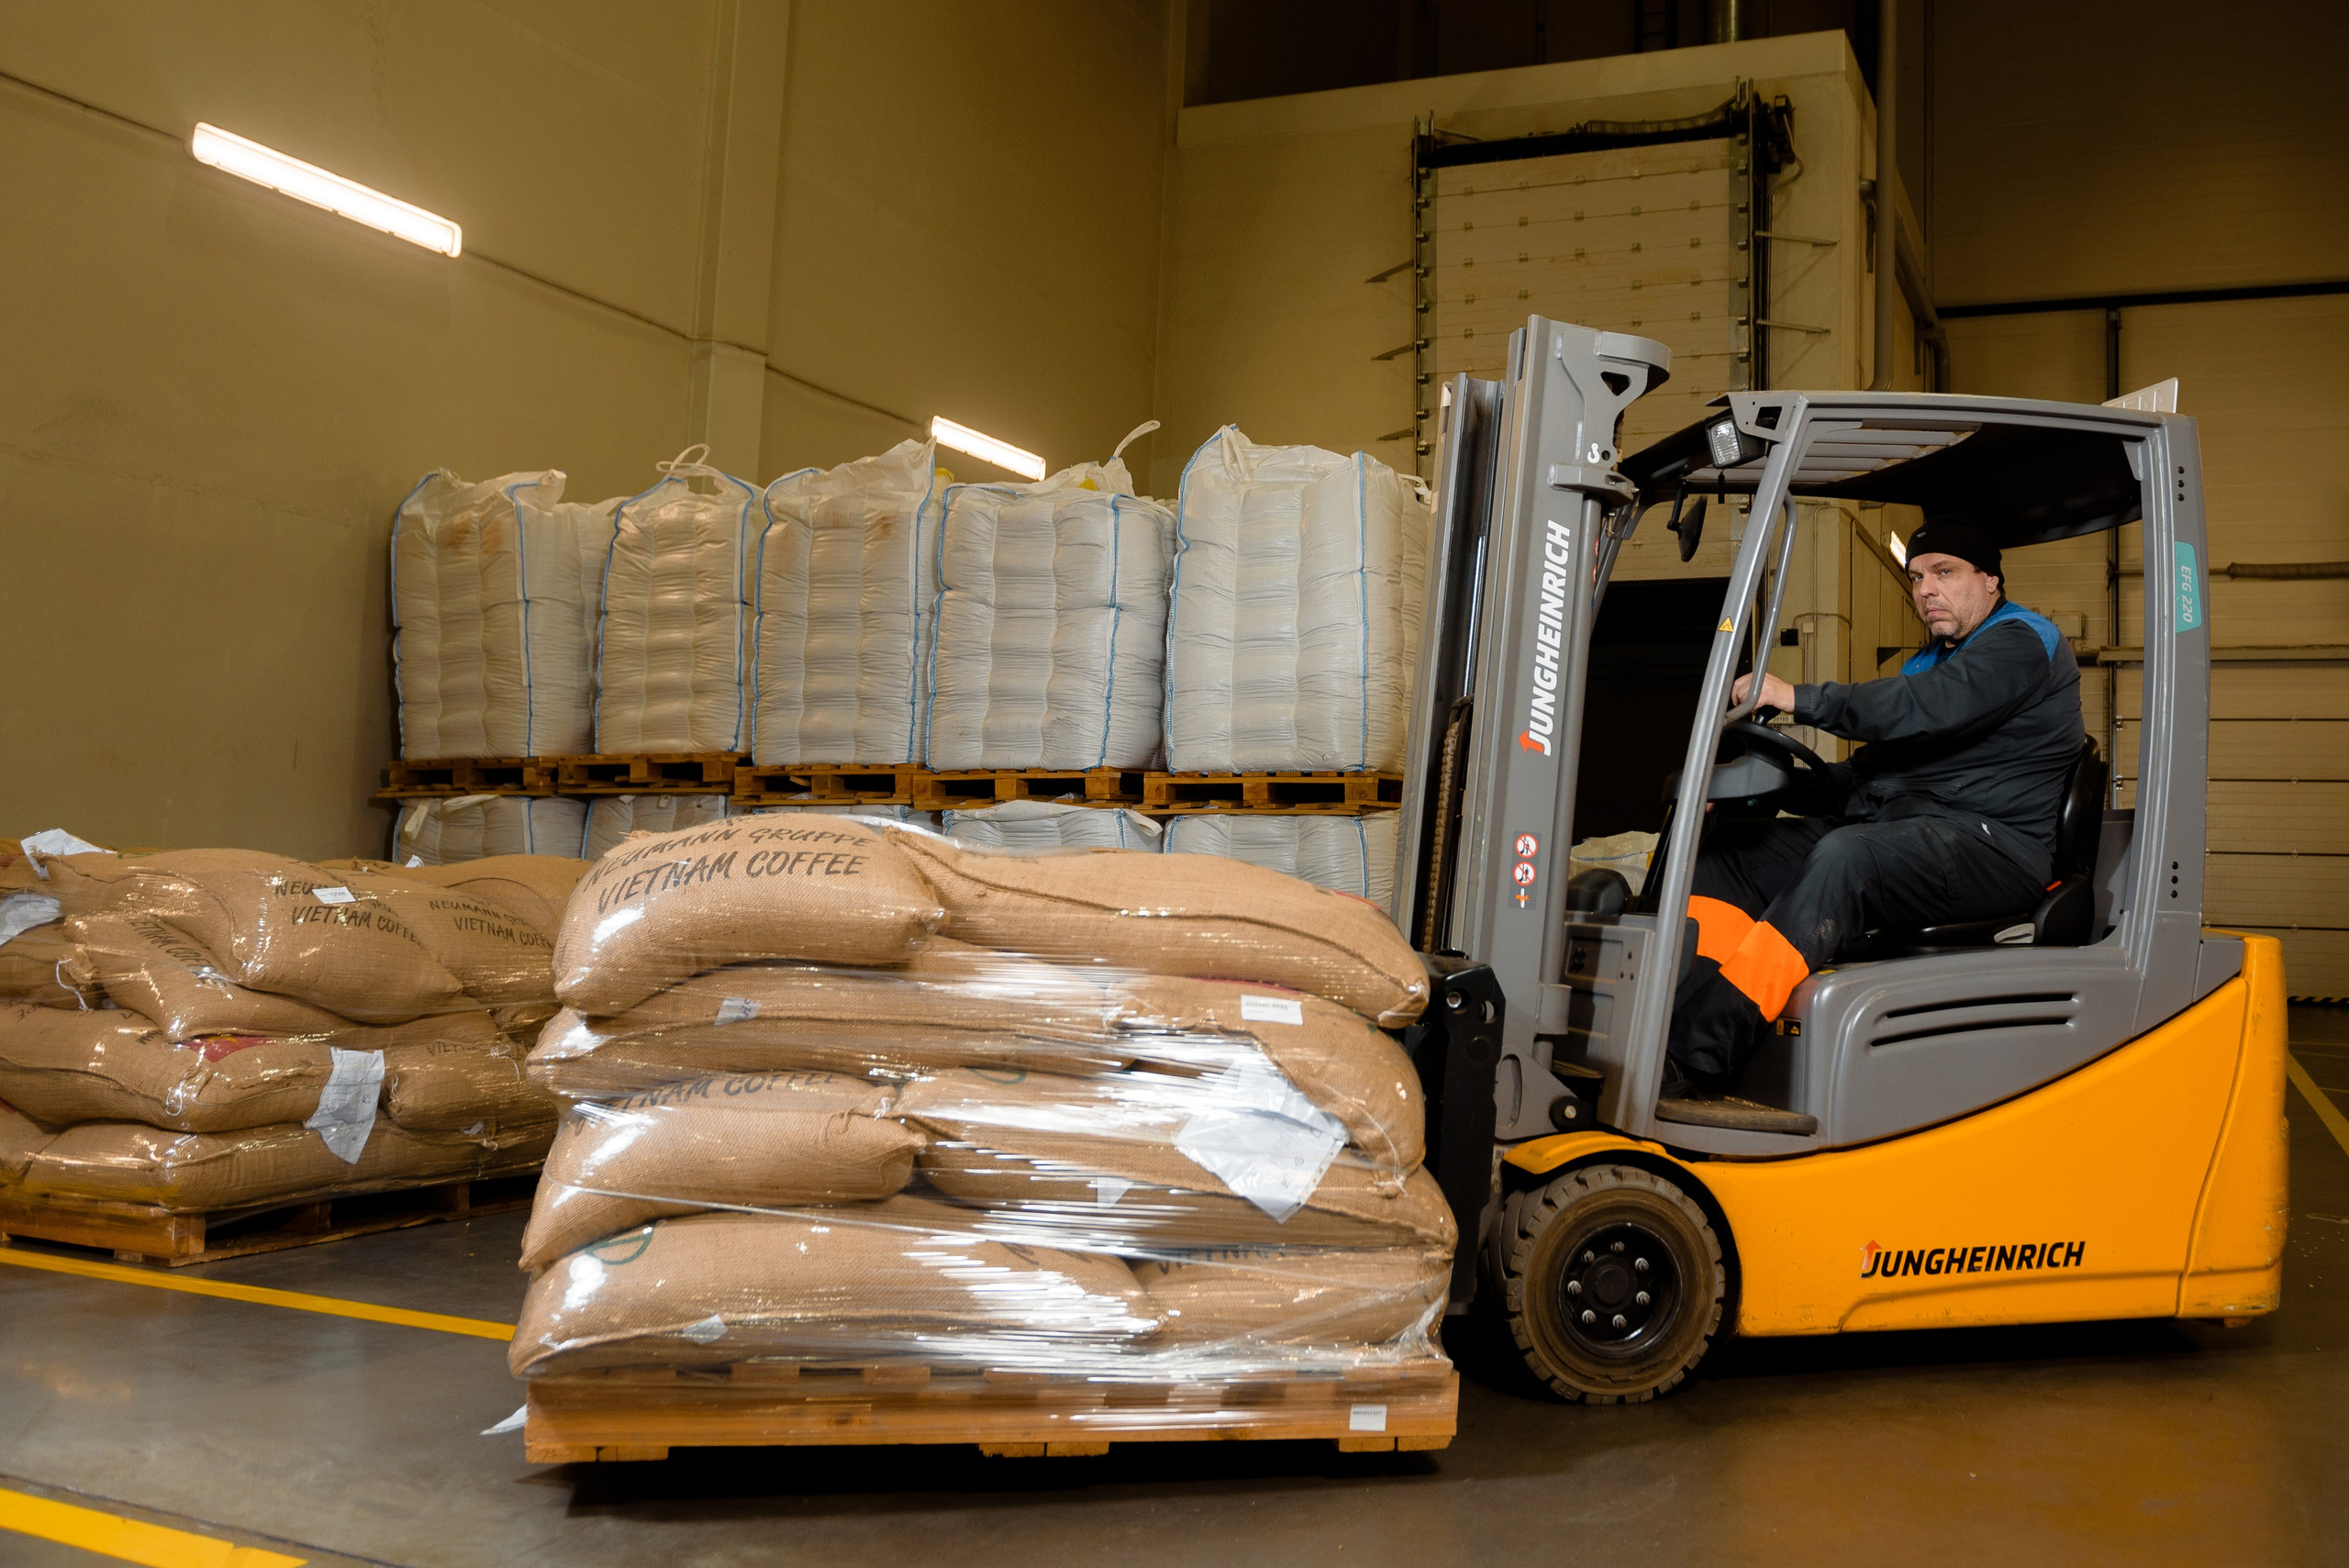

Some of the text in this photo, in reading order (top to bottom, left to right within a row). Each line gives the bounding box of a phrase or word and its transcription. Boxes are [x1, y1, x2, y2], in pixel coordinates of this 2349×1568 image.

[2180, 565, 2194, 623] EFG 220
[1528, 519, 1571, 757] JUNGHEINRICH
[583, 827, 877, 894] NEUMANN GRUPPE
[597, 850, 869, 916] VIETNAM COFFEE
[453, 916, 517, 943] VIETNAM
[1859, 1240, 2087, 1279] JUNGHEINRICH
